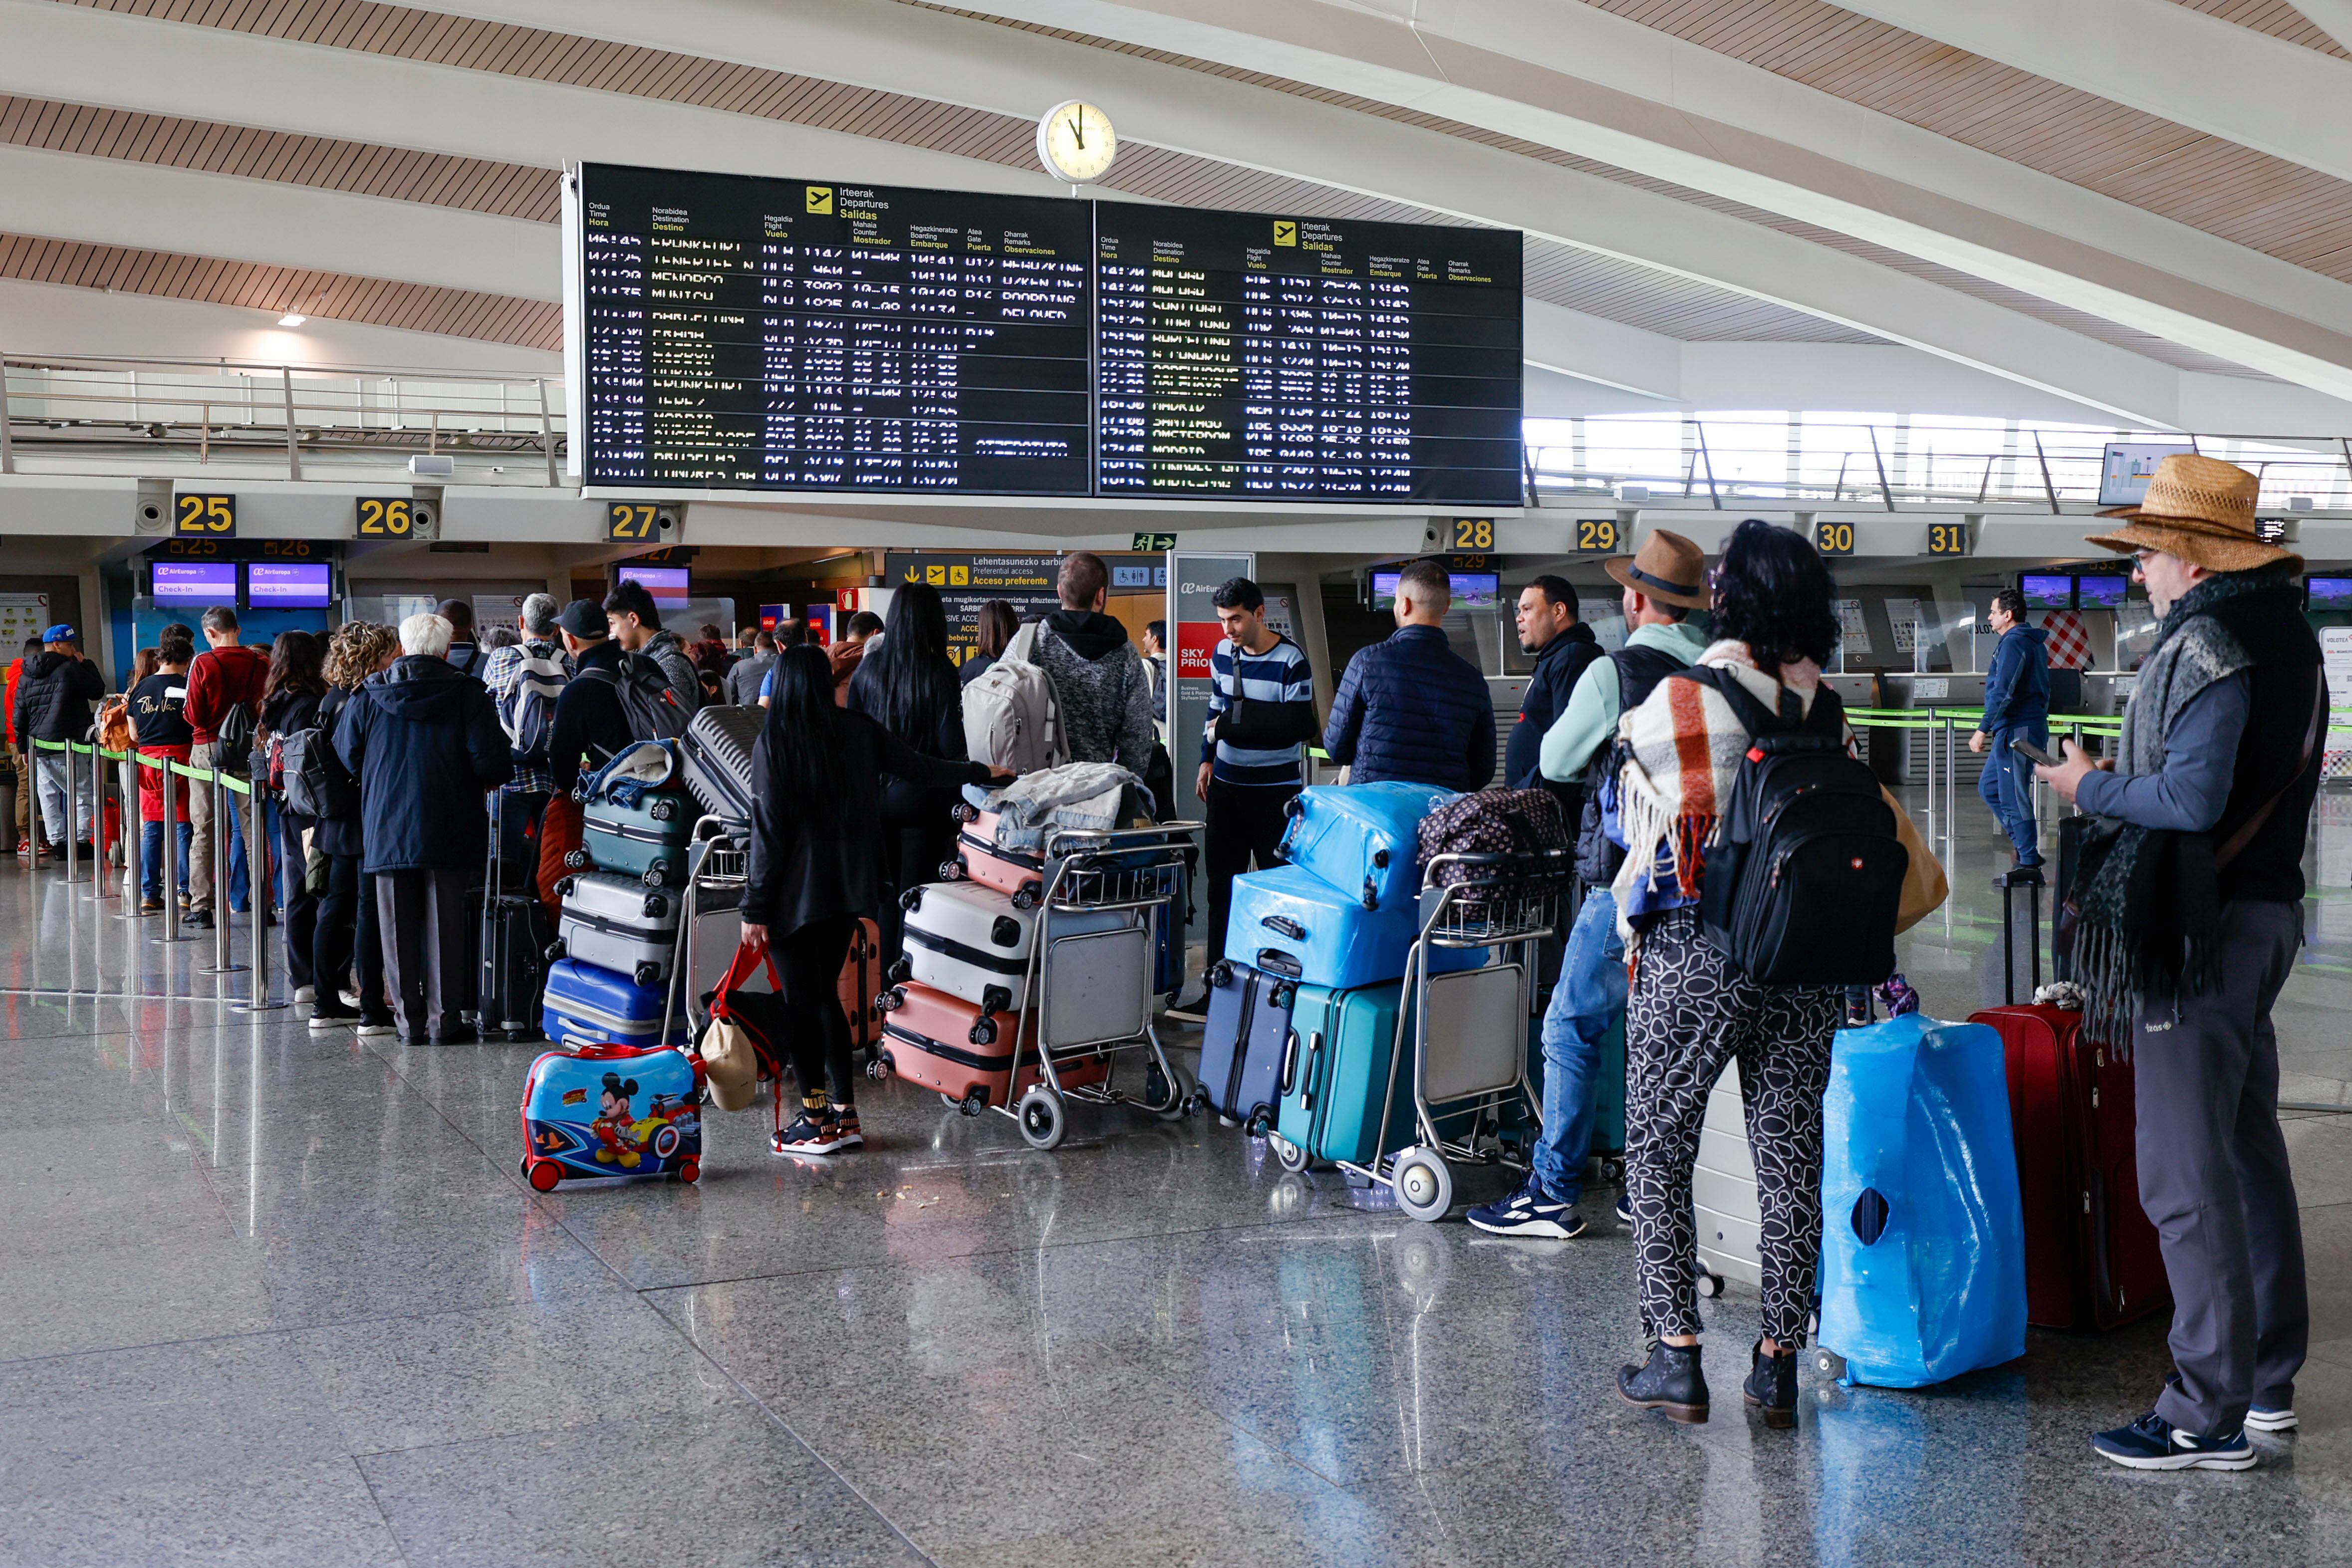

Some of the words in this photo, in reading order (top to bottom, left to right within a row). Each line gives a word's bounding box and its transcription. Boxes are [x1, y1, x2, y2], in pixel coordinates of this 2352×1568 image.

[840, 187, 874, 198] Irteerak
[840, 198, 889, 209] Departures
[653, 215, 689, 223] Destination
[840, 209, 877, 220] Salidas
[653, 223, 684, 231] Destino
[765, 222, 782, 231] Flight
[910, 225, 958, 234] Hegazkineratze
[1302, 222, 1330, 232] Irteerak
[765, 230, 787, 238] Vuelo
[910, 232, 937, 241] Boarding
[1302, 231, 1342, 242] Departures
[853, 236, 891, 245] Mostrador
[911, 240, 948, 250] Embarque
[1005, 246, 1055, 255] Observaciones
[1303, 241, 1333, 251] Salidas
[1370, 269, 1401, 278] Embarque
[1448, 274, 1491, 282] Observaciones
[179, 496, 232, 531] 25
[361, 500, 409, 533] 26
[612, 506, 656, 537] 27
[1456, 521, 1492, 548] 28
[1580, 522, 1614, 549] 29
[1820, 524, 1852, 551] 30
[1931, 526, 1960, 552] 31
[188, 538, 217, 554] 25
[281, 540, 309, 556] 26
[974, 557, 1038, 566] Lehentasunezko
[1465, 554, 1485, 568] 29
[973, 576, 1003, 585] Acceso
[1005, 576, 1047, 586] preferente
[1181, 649, 1205, 658] SKY
